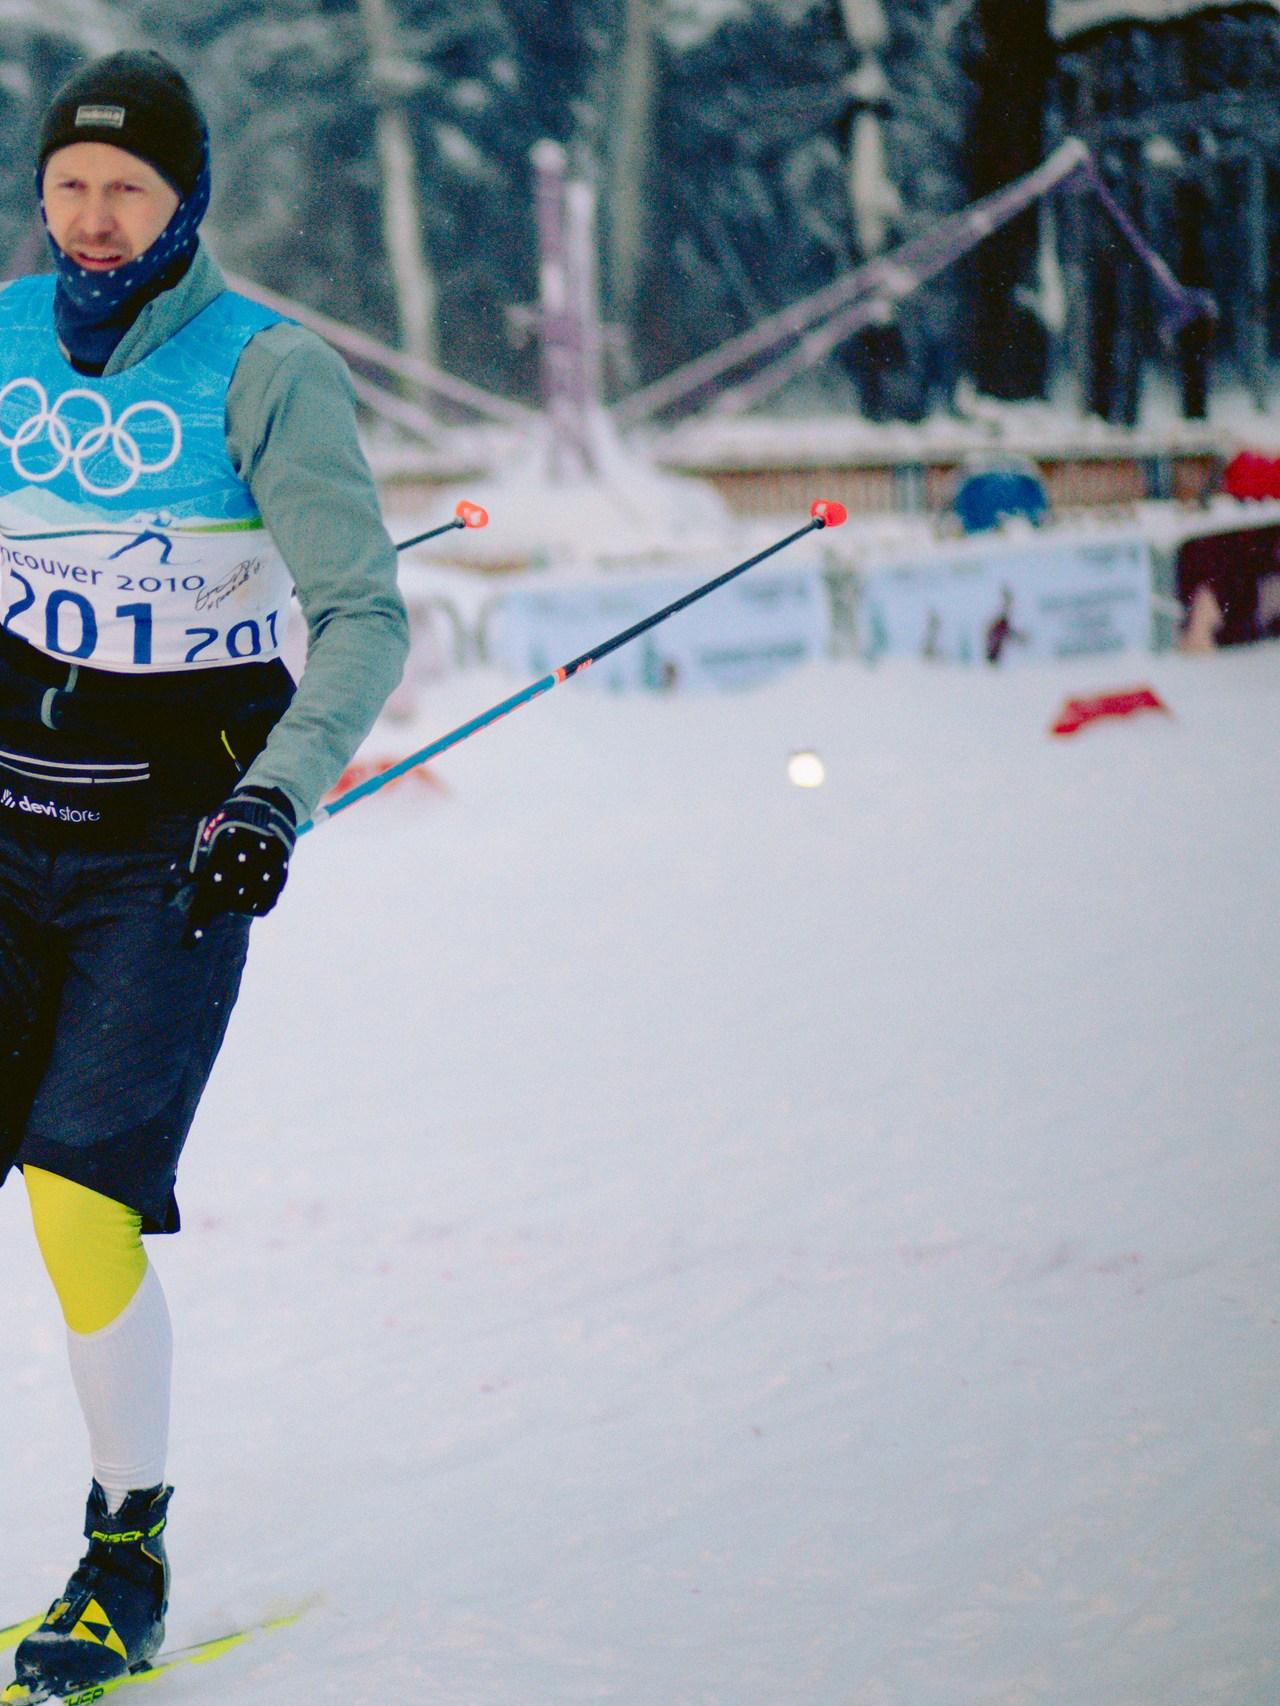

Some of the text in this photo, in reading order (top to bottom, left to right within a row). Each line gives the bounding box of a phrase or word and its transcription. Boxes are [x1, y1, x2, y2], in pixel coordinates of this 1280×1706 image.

[116, 575, 205, 592] 2010
[3, 568, 153, 665] 201
[184, 610, 279, 663] 201
[18, 795, 100, 822] devi store
